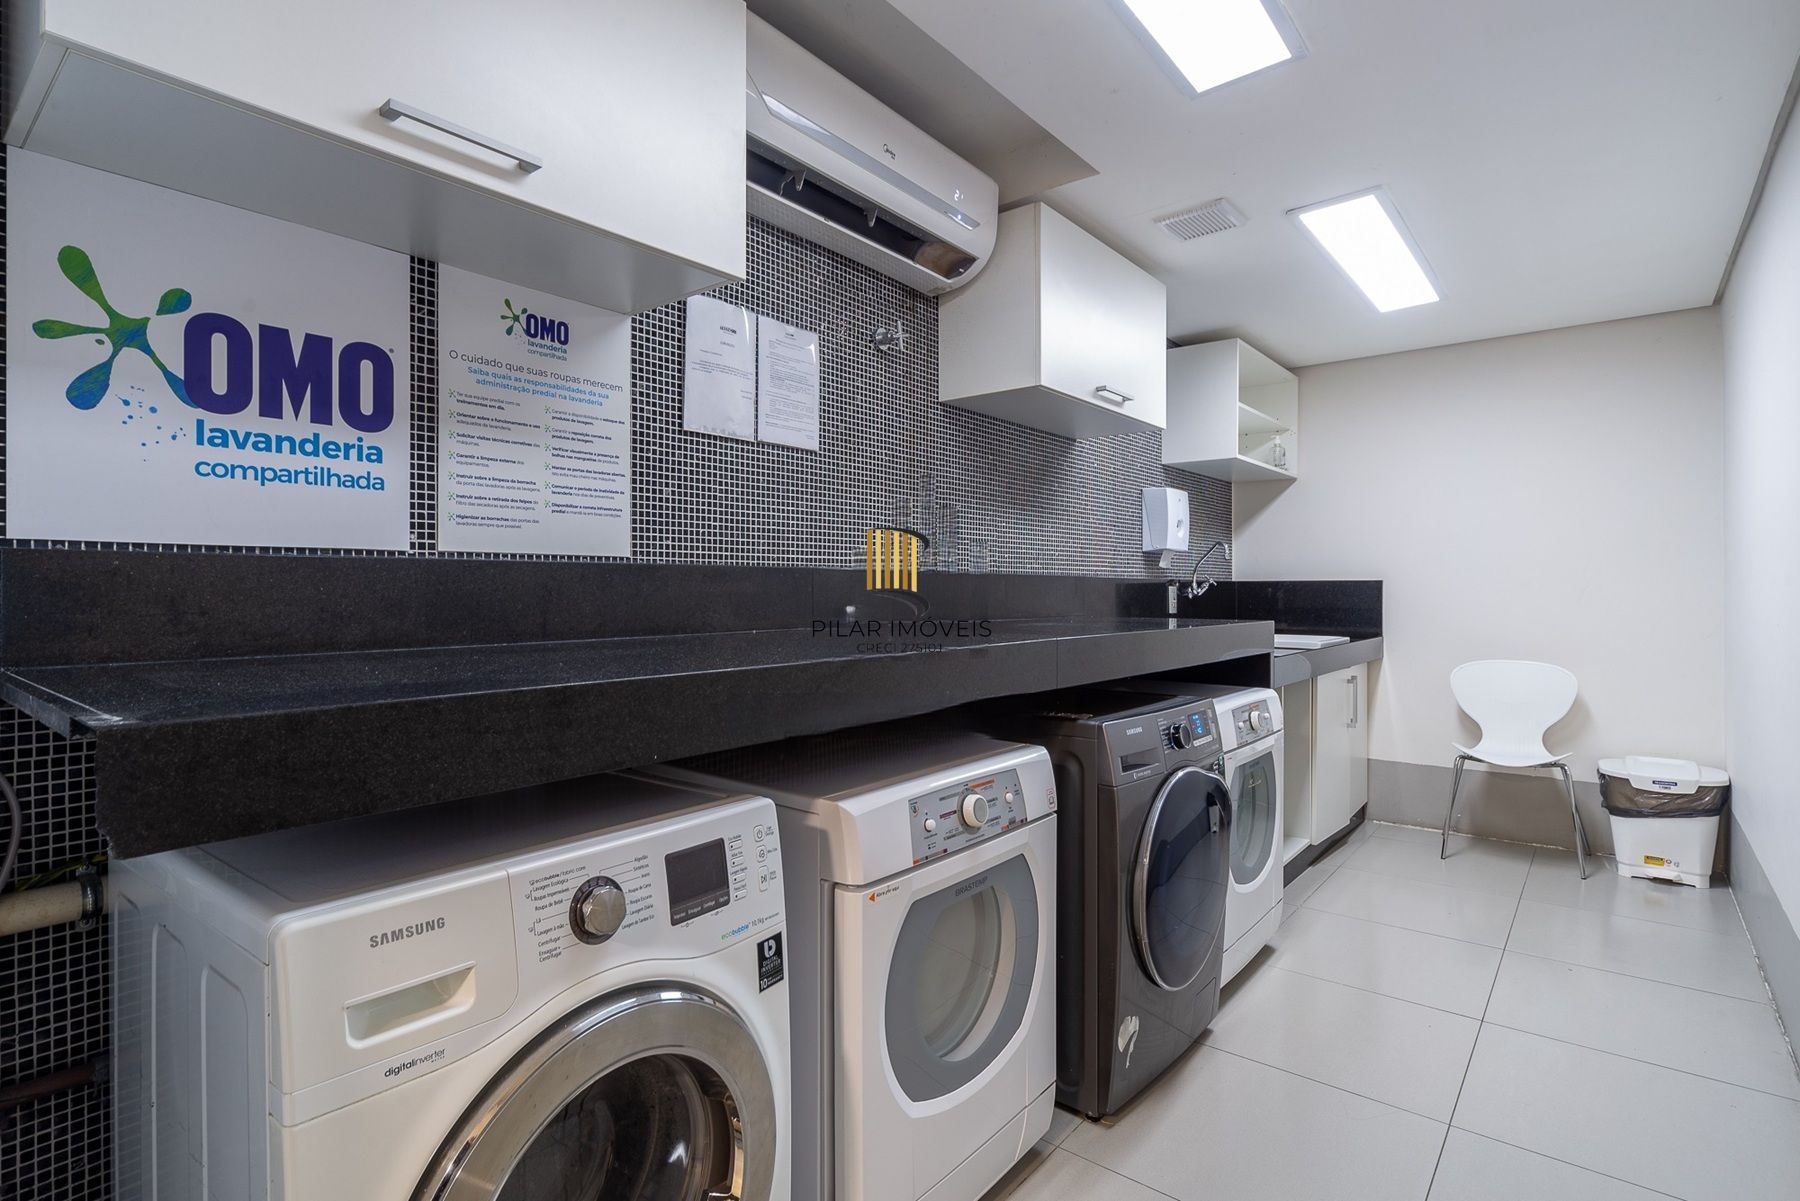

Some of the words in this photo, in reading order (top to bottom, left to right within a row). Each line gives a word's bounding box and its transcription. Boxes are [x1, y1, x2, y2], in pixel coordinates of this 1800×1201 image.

[526, 314, 569, 346] OMO
[528, 339, 567, 354] lavanderia
[528, 350, 567, 361] compartilhada
[184, 312, 394, 432] OMO
[449, 350, 458, 359] O
[461, 353, 503, 368] cuidado
[506, 363, 524, 372] que
[527, 367, 548, 378] suas
[550, 372, 580, 384] roupas
[583, 379, 623, 392] merecem
[468, 367, 489, 376] Saiba
[491, 371, 512, 380] quais
[524, 378, 586, 395] responsabilidades
[476, 378, 530, 393] administração
[532, 388, 556, 398] predial
[569, 395, 603, 406] lavanderia
[196, 419, 384, 464] lavanderia
[195, 461, 385, 491] compartilhada
[1126, 727, 1142, 735] SAMSUNG
[955, 876, 988, 896] BRASTEMP
[370, 917, 446, 948] SAMSUNG
[537, 928, 552, 936] Lavagem
[761, 978, 768, 990] 10
